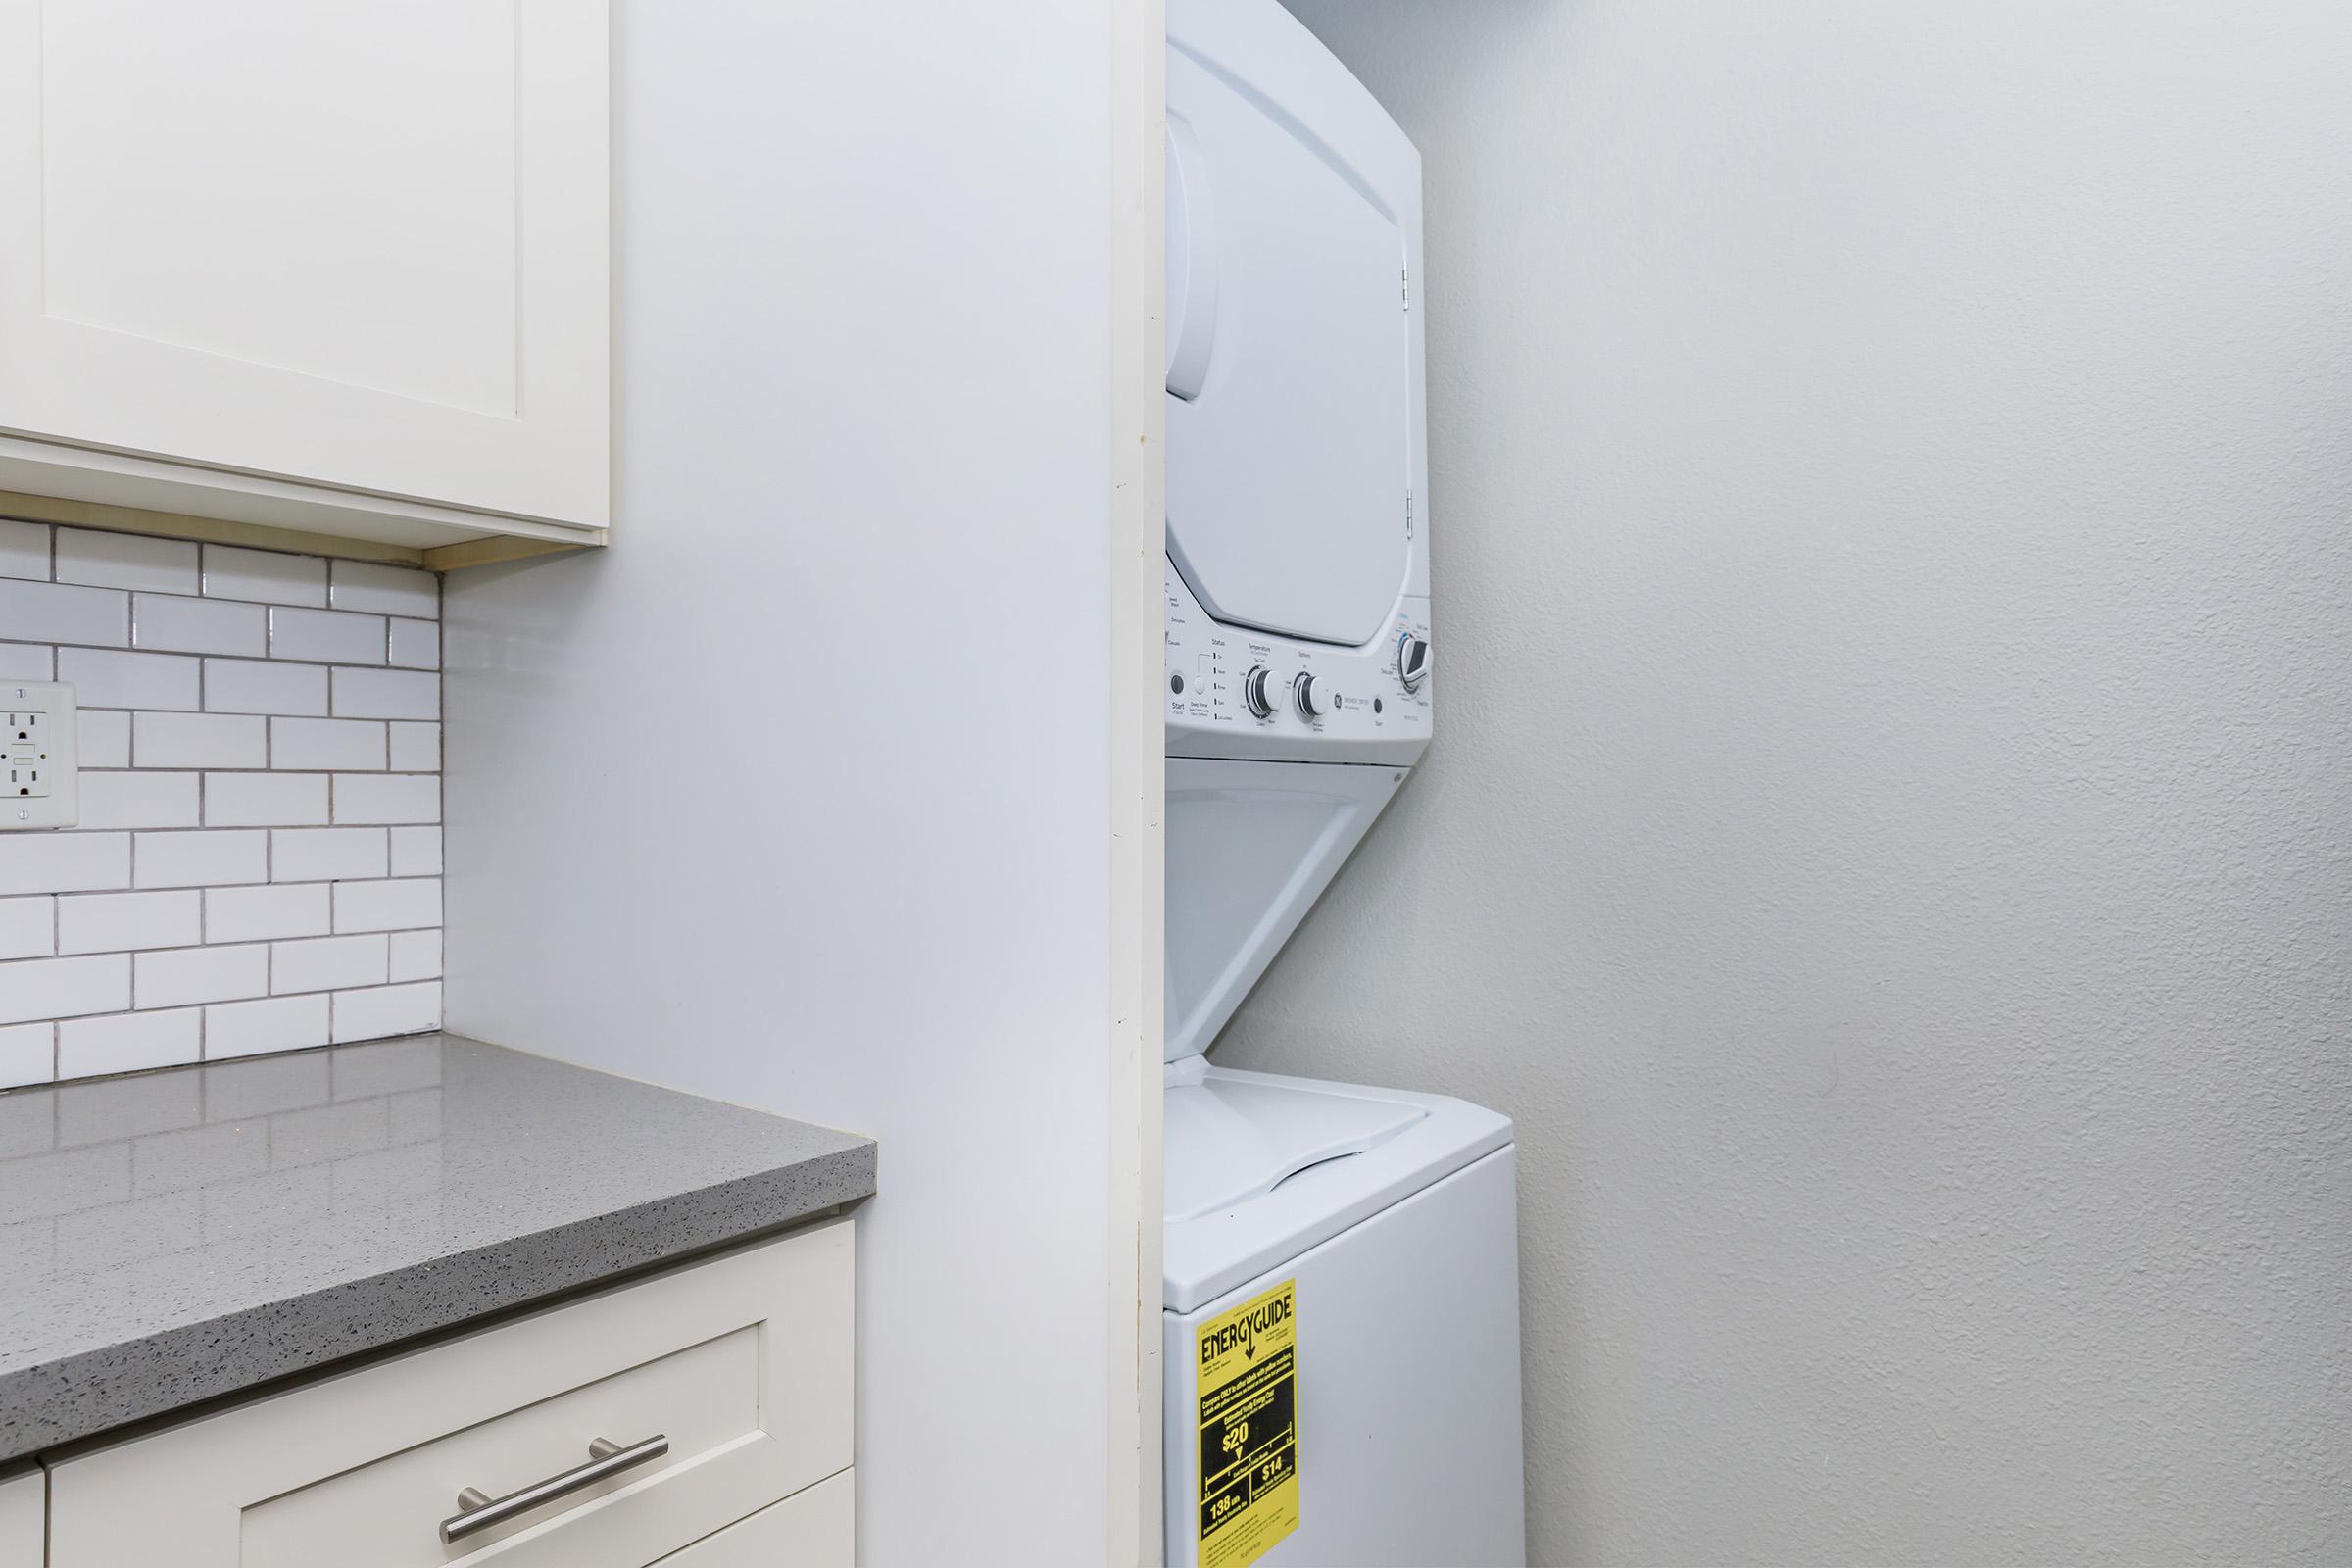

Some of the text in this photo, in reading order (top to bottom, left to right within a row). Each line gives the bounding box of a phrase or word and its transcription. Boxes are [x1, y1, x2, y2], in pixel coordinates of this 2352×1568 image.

[1249, 643, 1270, 652] Temperature
[1202, 1294, 1292, 1364] ENERGYGUIDE
[1202, 1395, 1220, 1410] Compare
[1221, 1388, 1232, 1399] ONLY
[1236, 1379, 1246, 1390] other
[1246, 1372, 1257, 1385] labels
[1265, 1363, 1276, 1374] yellow
[1224, 1409, 1242, 1425] Estimated
[1253, 1396, 1266, 1407] Energy
[1223, 1422, 1248, 1452] $20
[1262, 1456, 1282, 1481] $14
[1211, 1495, 1230, 1519] 138
